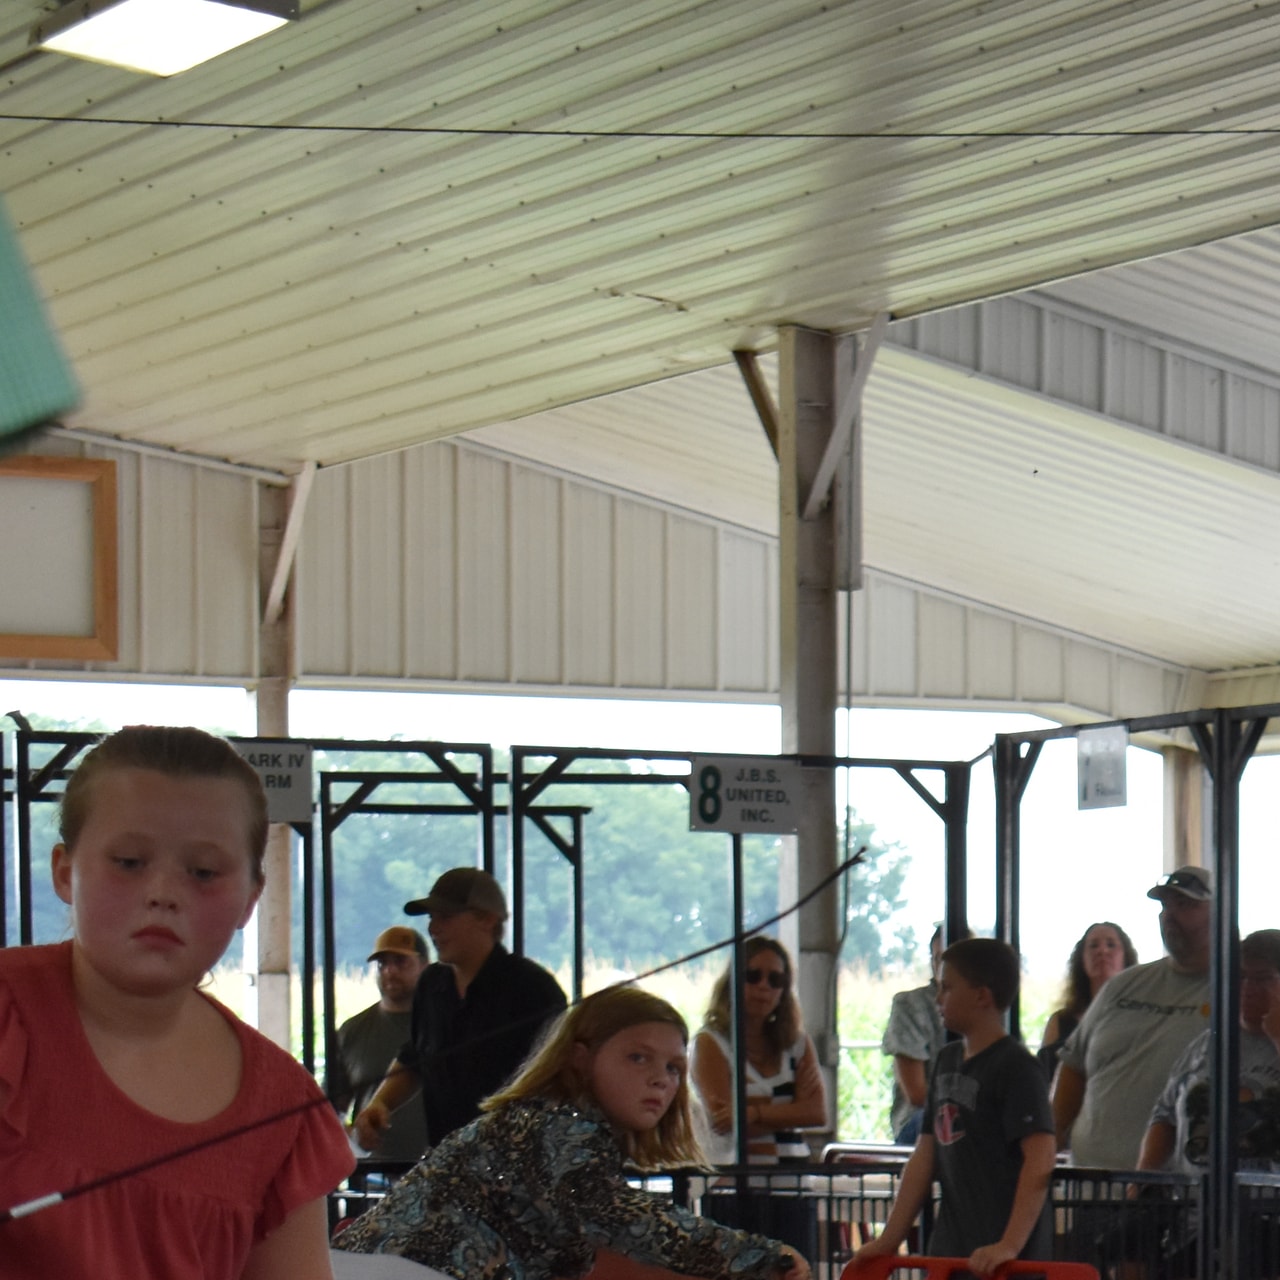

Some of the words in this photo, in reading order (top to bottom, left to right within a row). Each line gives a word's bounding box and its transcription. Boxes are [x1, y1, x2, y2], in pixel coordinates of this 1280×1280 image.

[243, 753, 282, 768] ARK
[288, 753, 305, 768] IV
[265, 774, 292, 789] RM
[736, 768, 781, 783] J.B.S.
[698, 765, 722, 824] 8
[726, 788, 791, 805] UNITED,
[741, 809, 775, 823] INC.
